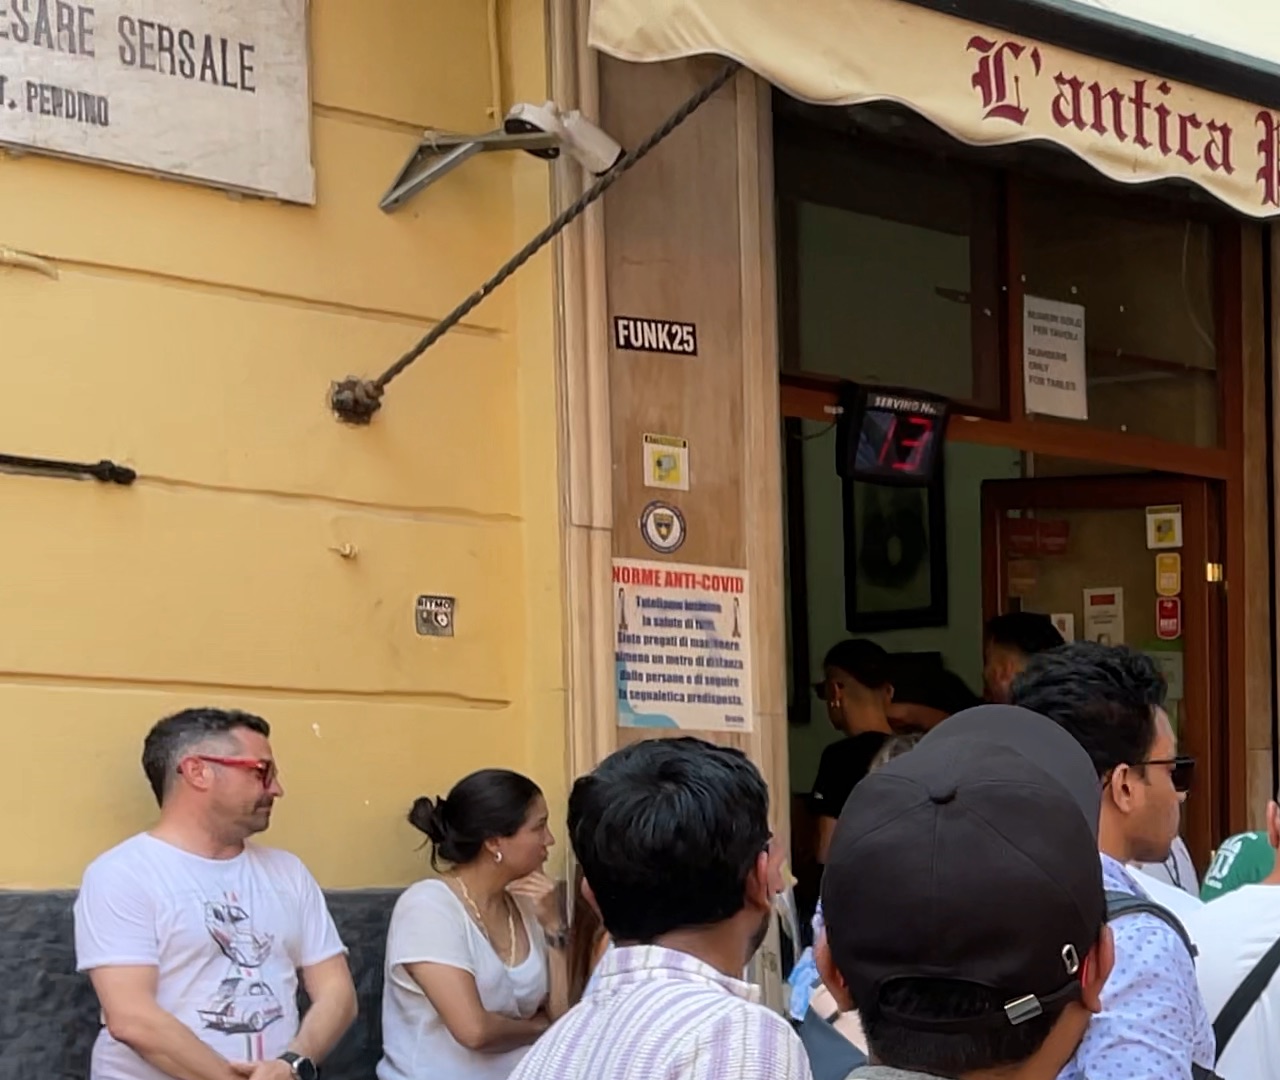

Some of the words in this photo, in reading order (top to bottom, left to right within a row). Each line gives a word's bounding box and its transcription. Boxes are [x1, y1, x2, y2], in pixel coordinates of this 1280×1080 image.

[117, 15, 256, 93] SERSALE
[26, 80, 109, 127] PENDINO
[966, 34, 1236, 176] L'antica
[617, 319, 696, 353] FUNK25
[874, 396, 919, 411] SERVING
[612, 566, 661, 587] NORME
[664, 571, 744, 594] ANTI-COVID
[642, 615, 651, 627] la
[653, 615, 683, 629] salute
[685, 619, 693, 630] di
[643, 633, 677, 648] pregati
[679, 635, 689, 648] di
[652, 654, 664, 665] un
[666, 655, 693, 667] metro
[695, 656, 705, 668] di
[645, 671, 685, 685] persone
[694, 674, 703, 685] di
[704, 675, 740, 688] seguire
[629, 689, 685, 703] segnaletica
